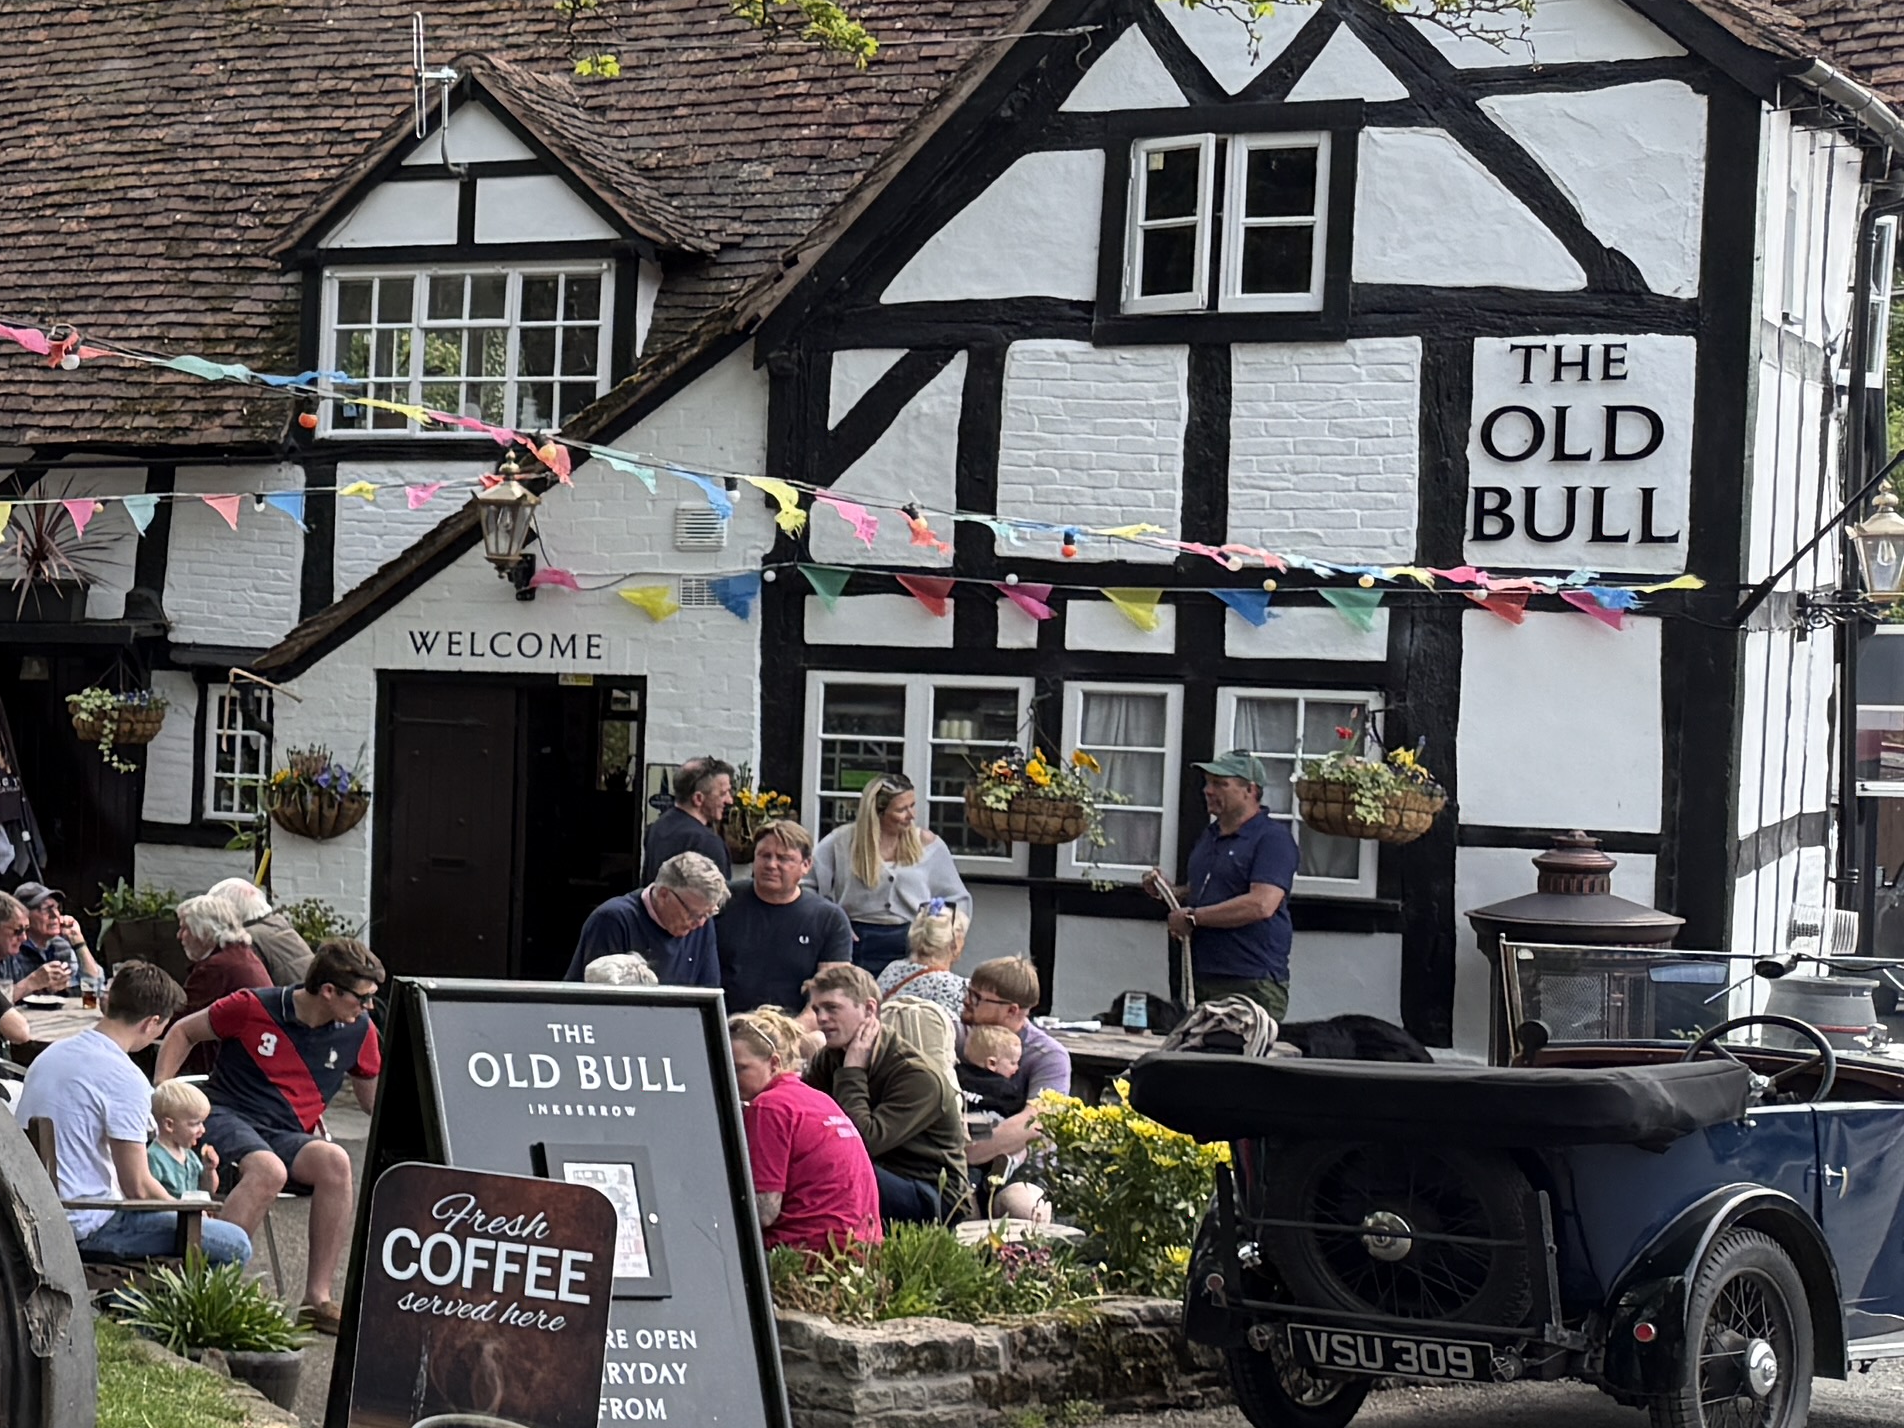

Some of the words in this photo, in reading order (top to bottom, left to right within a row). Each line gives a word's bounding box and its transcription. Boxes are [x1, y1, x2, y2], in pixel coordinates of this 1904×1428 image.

[1509, 342, 1628, 384] THE
[1480, 405, 1664, 463] OLD
[1468, 485, 1680, 544] BULL
[408, 630, 603, 660] WELCOME
[257, 1032, 278, 1057] 3
[547, 1023, 596, 1045] THE
[468, 1052, 561, 1088] OLD
[576, 1055, 686, 1092] BULL
[528, 1103, 637, 1117] INKBERROW
[431, 1193, 551, 1240] Fresh
[382, 1227, 593, 1305] COFFEE
[397, 1291, 498, 1321] served
[498, 1301, 567, 1332] here
[636, 1329, 697, 1350] OPEN
[1305, 1330, 1384, 1369] VSU
[1392, 1340, 1475, 1379] 309
[602, 1362, 687, 1385] RYDAY
[598, 1397, 668, 1420] FROM
